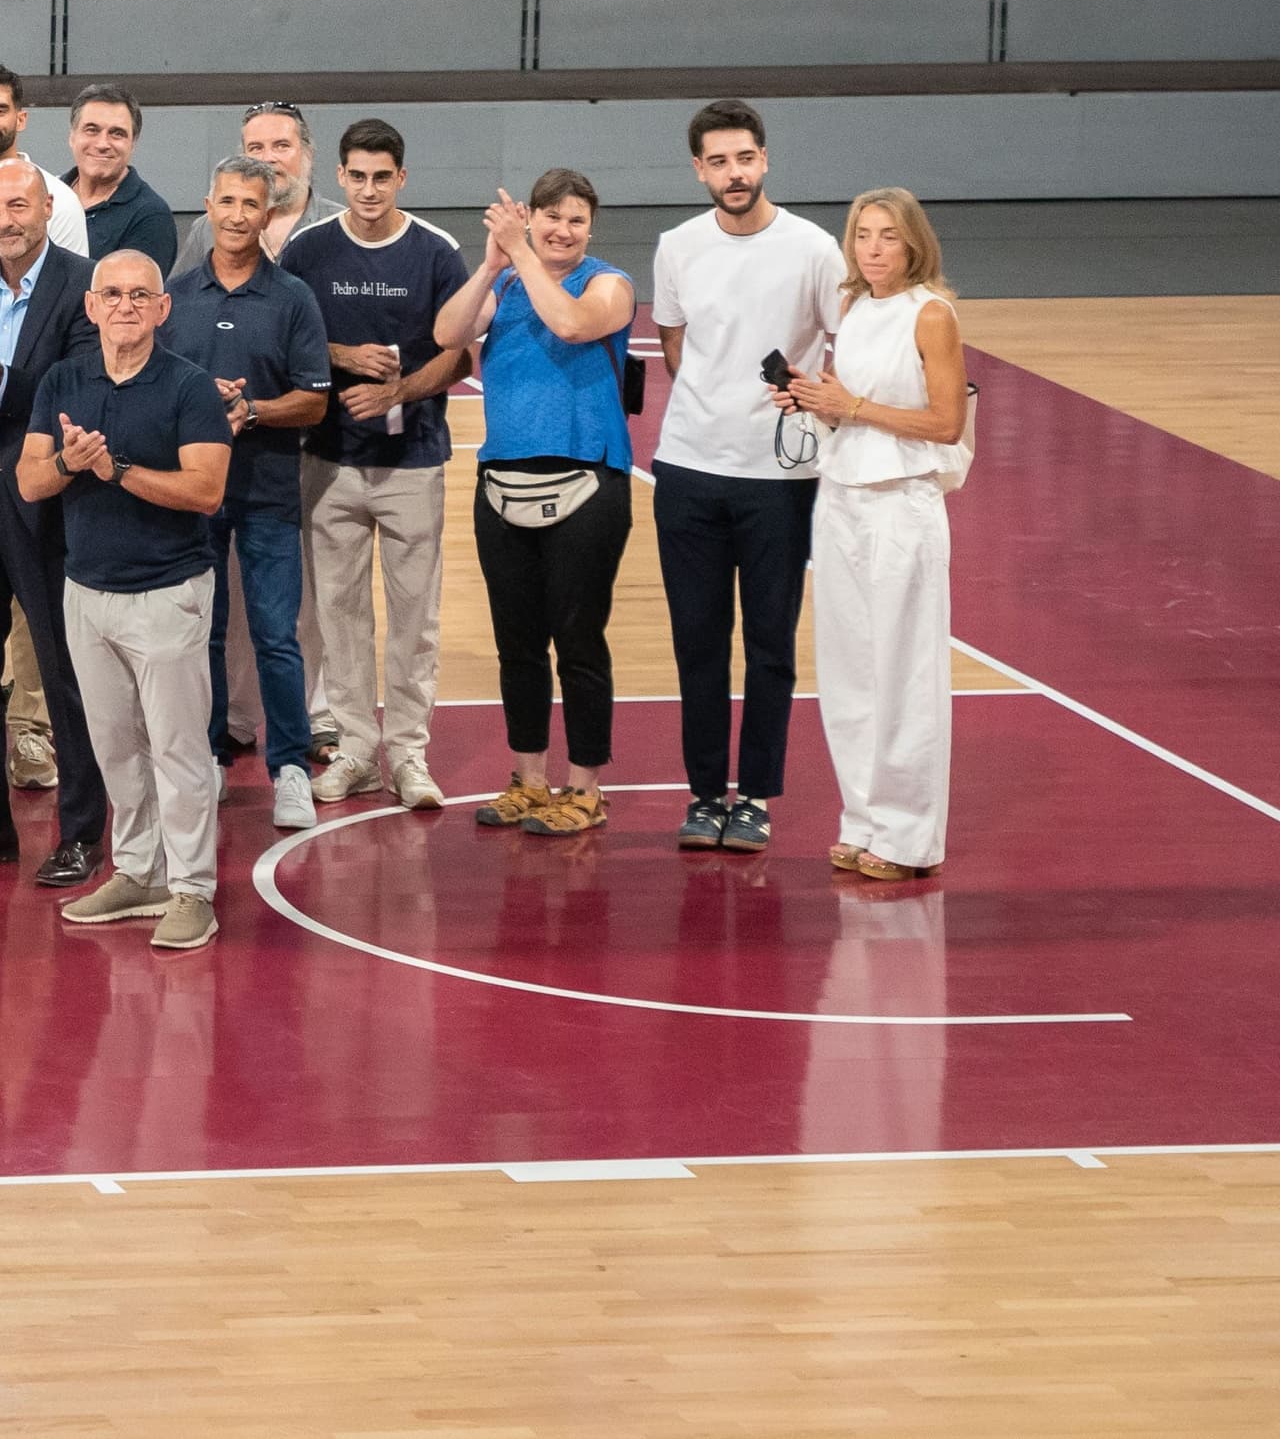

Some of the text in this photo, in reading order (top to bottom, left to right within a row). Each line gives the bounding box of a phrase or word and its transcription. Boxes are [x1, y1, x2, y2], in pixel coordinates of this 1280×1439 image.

[332, 281, 408, 298] Pedro del Hierro
